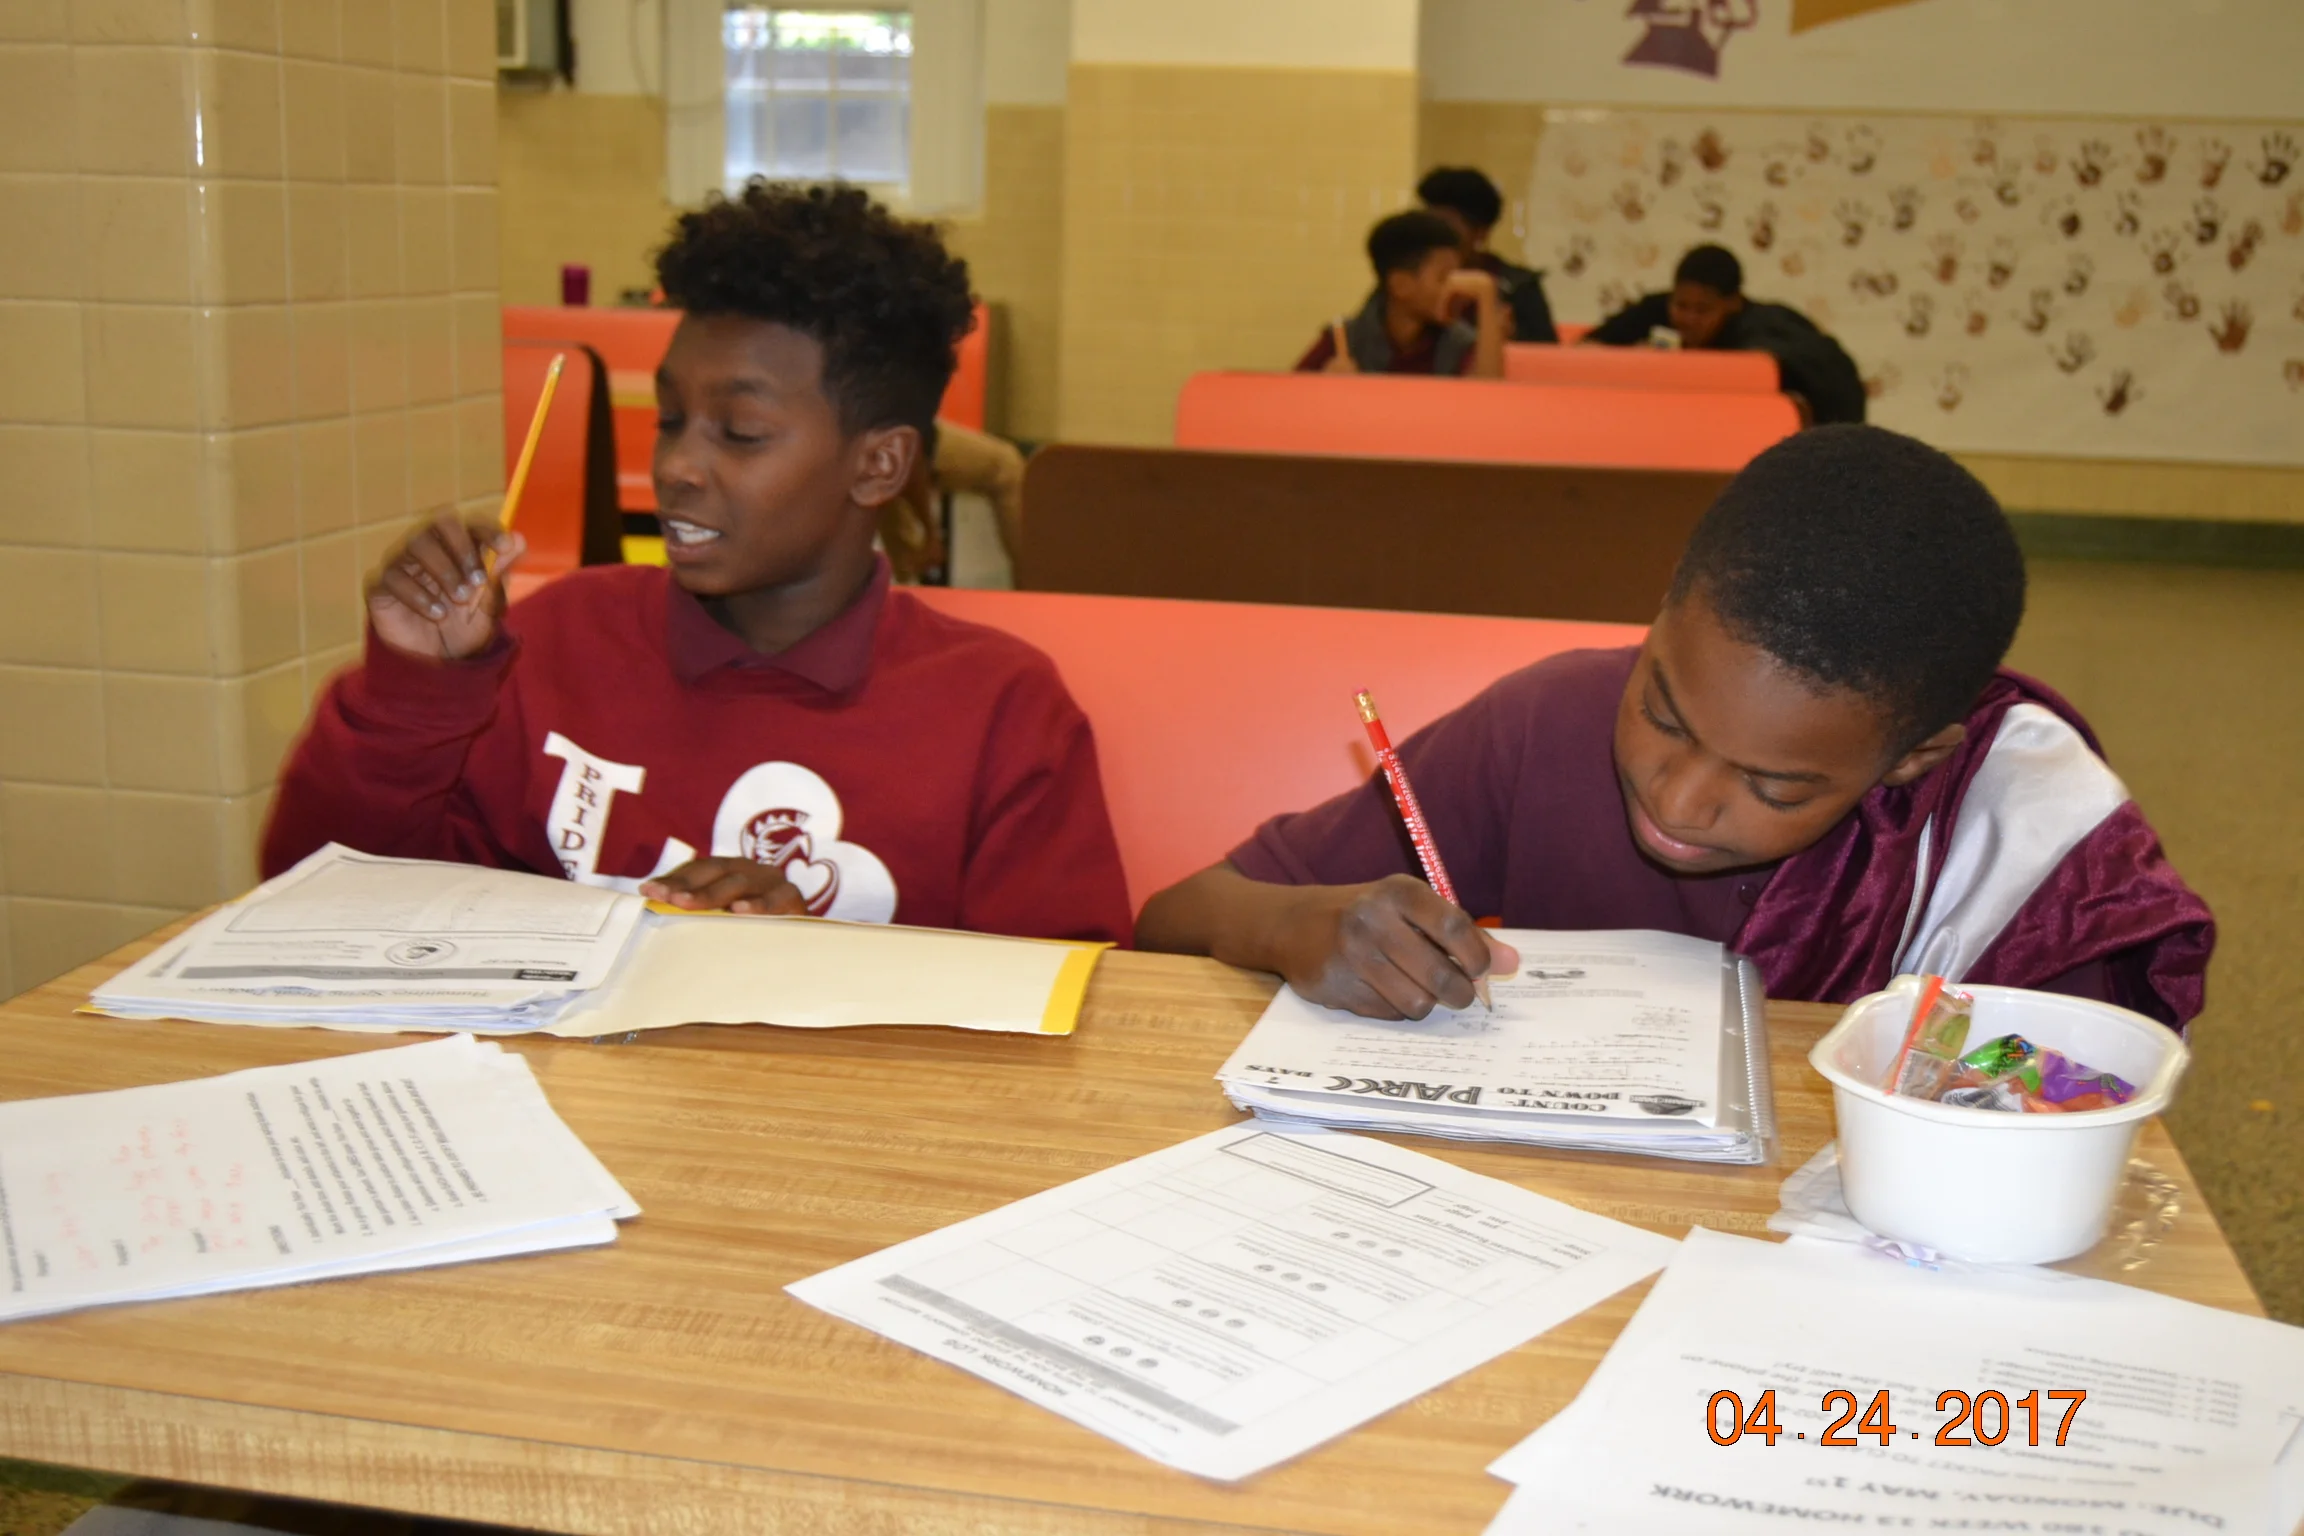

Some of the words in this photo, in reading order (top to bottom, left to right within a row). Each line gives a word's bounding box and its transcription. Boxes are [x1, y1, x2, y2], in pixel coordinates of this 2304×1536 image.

[1244, 1064, 1313, 1078] DAYS
[1322, 1075, 1482, 1106] PARCC
[1496, 1086, 1533, 1096] TO
[1540, 1090, 1620, 1100] DOWN
[941, 1338, 978, 1355] LOG
[979, 1354, 1068, 1397] HOMEWORK
[1858, 1482, 1939, 1500] MAY
[1649, 1484, 1864, 1524] HOMEWORK
[1952, 1490, 2126, 1510] MONDAY,
[1929, 1519, 2030, 1531] WEEK
